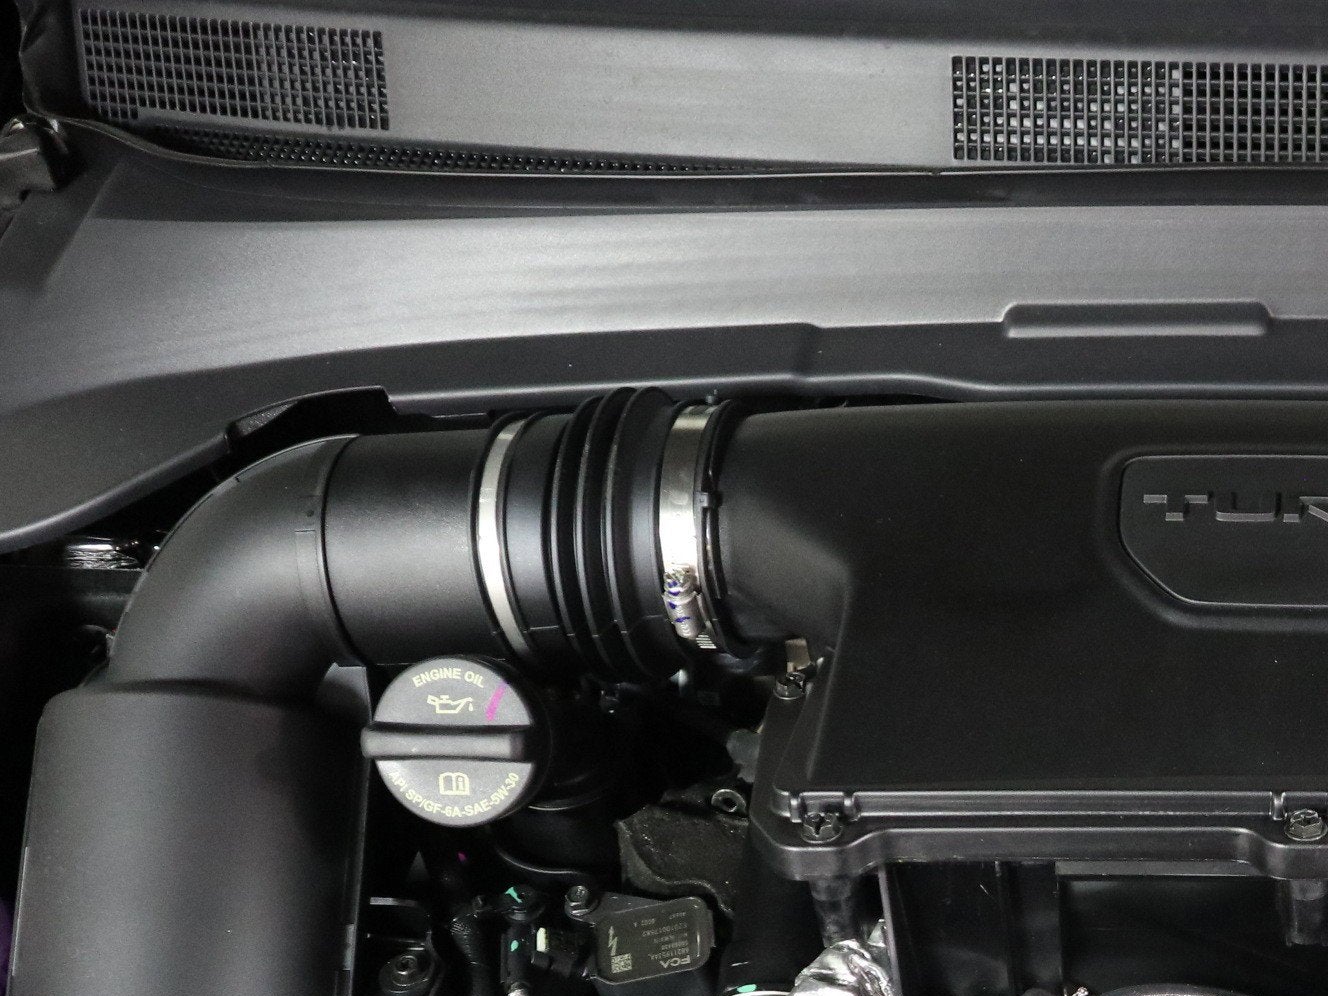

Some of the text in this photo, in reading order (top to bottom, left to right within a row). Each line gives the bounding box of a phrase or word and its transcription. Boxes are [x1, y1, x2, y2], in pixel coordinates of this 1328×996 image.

[412, 668, 485, 688] ENGINE OIL
[388, 771, 406, 792] API
[659, 955, 691, 969] FCA
